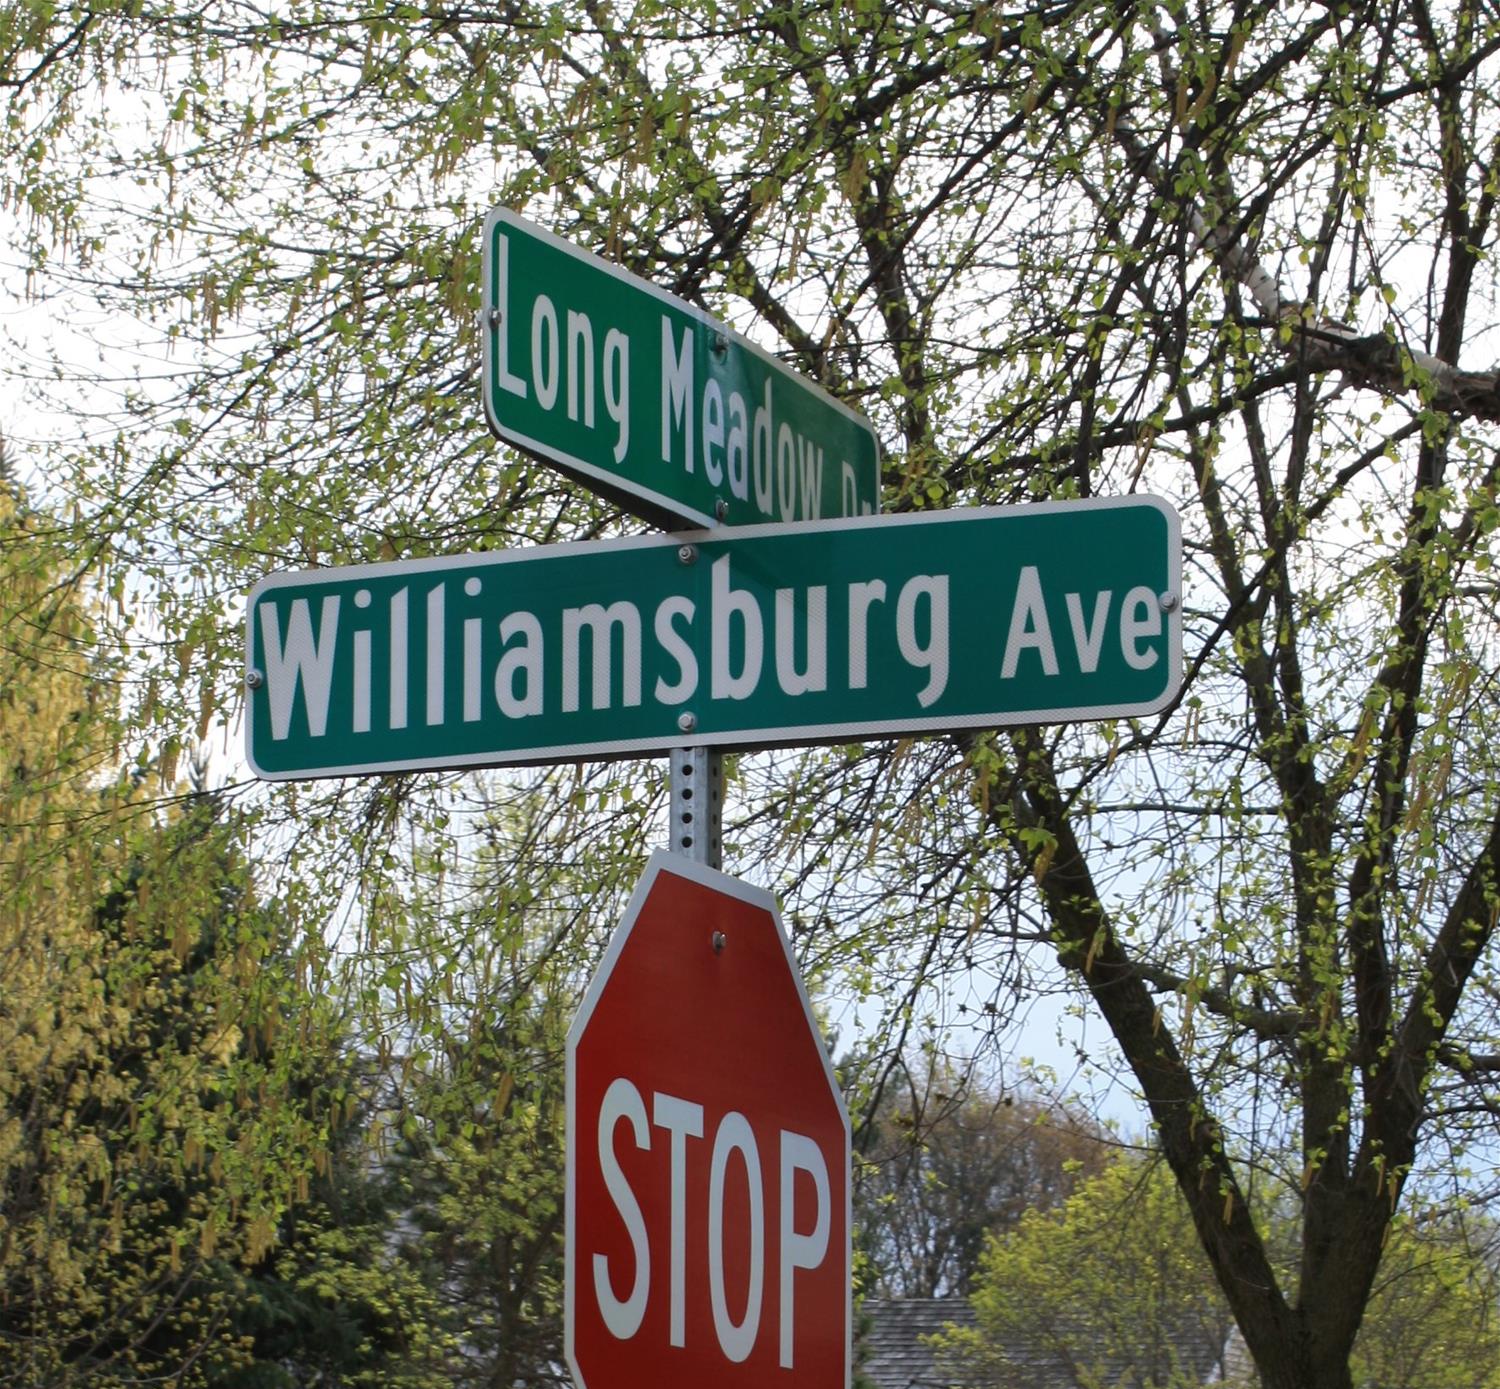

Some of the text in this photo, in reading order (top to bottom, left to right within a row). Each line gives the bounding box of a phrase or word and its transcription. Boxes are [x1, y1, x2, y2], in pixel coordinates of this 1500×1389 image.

[498, 233, 872, 522] Long Meadow D
[258, 553, 1162, 741] Williamsburg Ave
[592, 1077, 831, 1369] STOP
